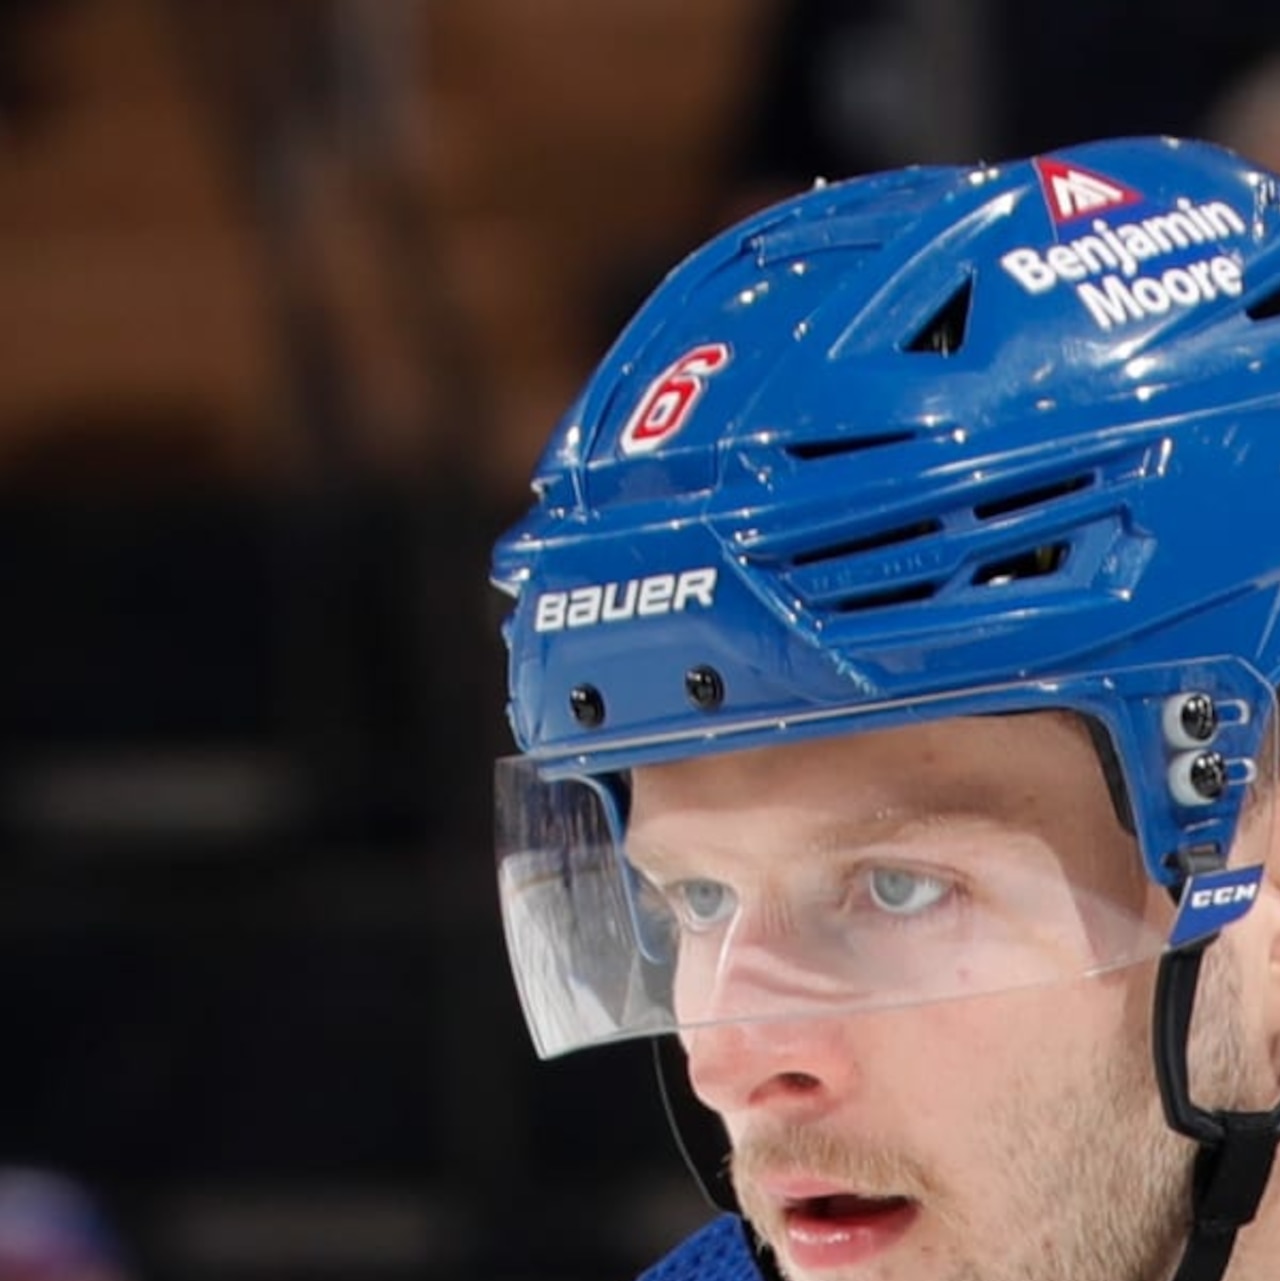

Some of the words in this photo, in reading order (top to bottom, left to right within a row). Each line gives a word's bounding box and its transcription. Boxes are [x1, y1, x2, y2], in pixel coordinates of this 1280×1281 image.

[1000, 196, 1246, 295] Benjamin
[1075, 253, 1244, 332] Moore
[619, 342, 729, 455] 6
[534, 567, 718, 632] BAUER
[1191, 882, 1258, 909] CCM
